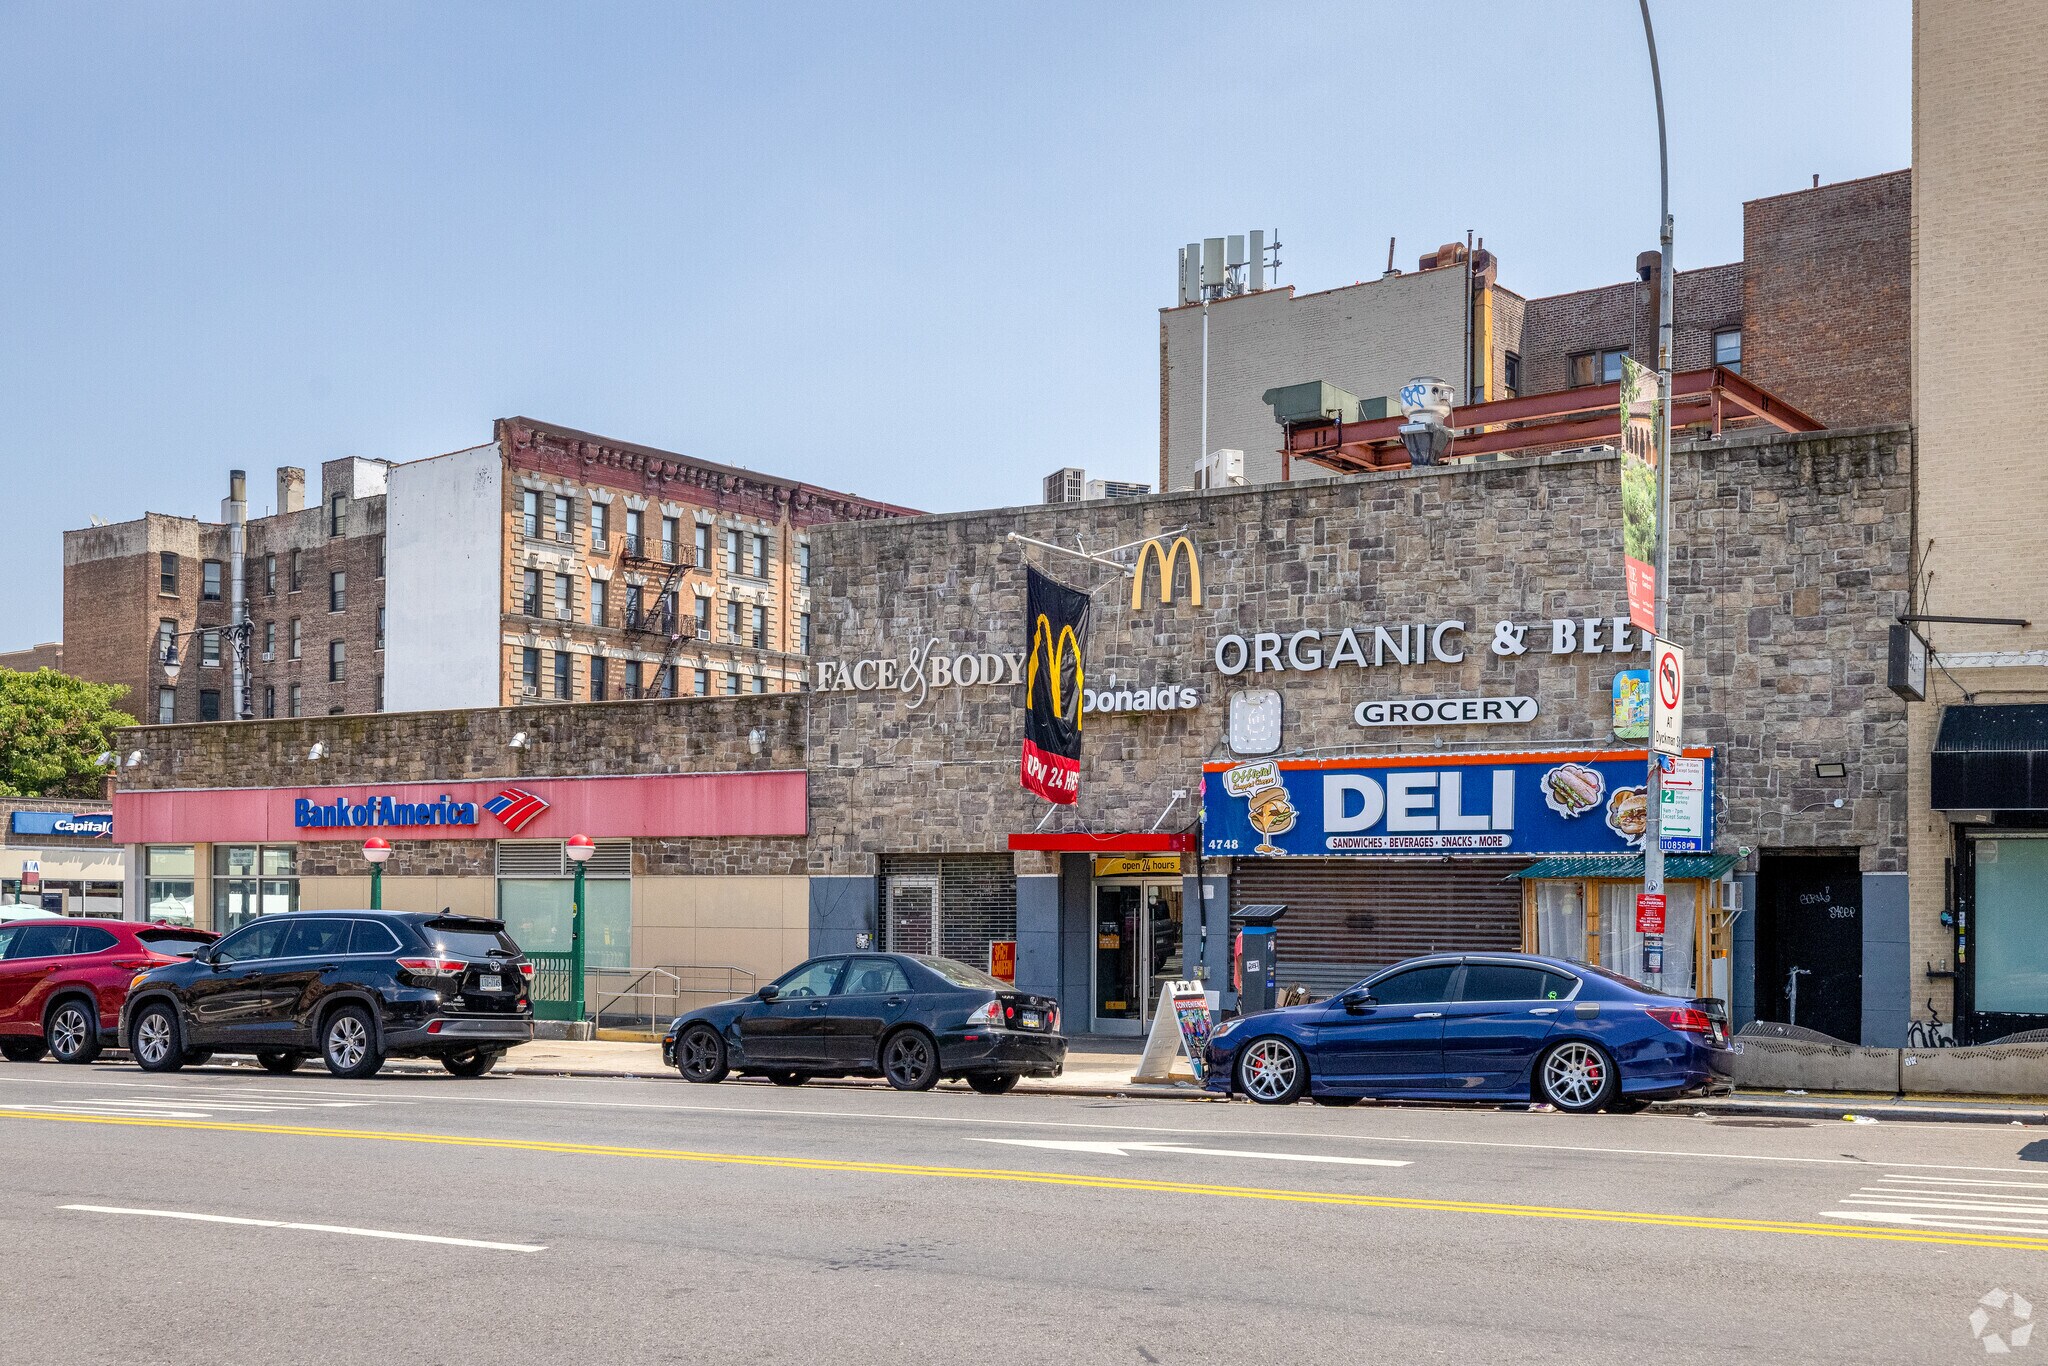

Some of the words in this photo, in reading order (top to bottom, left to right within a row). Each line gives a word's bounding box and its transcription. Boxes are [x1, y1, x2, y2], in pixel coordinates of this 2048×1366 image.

[1215, 620, 1466, 675] ORGANIC
[1491, 620, 1528, 656] &
[816, 659, 899, 692] FACE
[900, 637, 940, 709] &
[929, 652, 1027, 688] BODY
[1083, 685, 1198, 713] Donald's
[1362, 700, 1529, 723] GROCERY
[1666, 716, 1673, 728] AT
[1048, 767, 1064, 789] 24
[1231, 764, 1272, 784] Official
[1323, 769, 1515, 833] DELI
[1664, 790, 1672, 802] 2
[294, 797, 350, 827] Bank
[352, 796, 378, 827] of
[378, 795, 478, 826] America
[1208, 839, 1239, 849] 4748
[1332, 837, 1383, 849] SANDWICHES
[1389, 836, 1434, 848] BEVERAGES
[1441, 835, 1473, 847] SNACKS
[1479, 835, 1503, 847] MORE
[1661, 840, 1686, 850] 110858
[1122, 862, 1141, 872] open
[1141, 858, 1151, 872] 24
[1152, 860, 1175, 870] hours
[1175, 1000, 1207, 1009] CONVENIENCE
